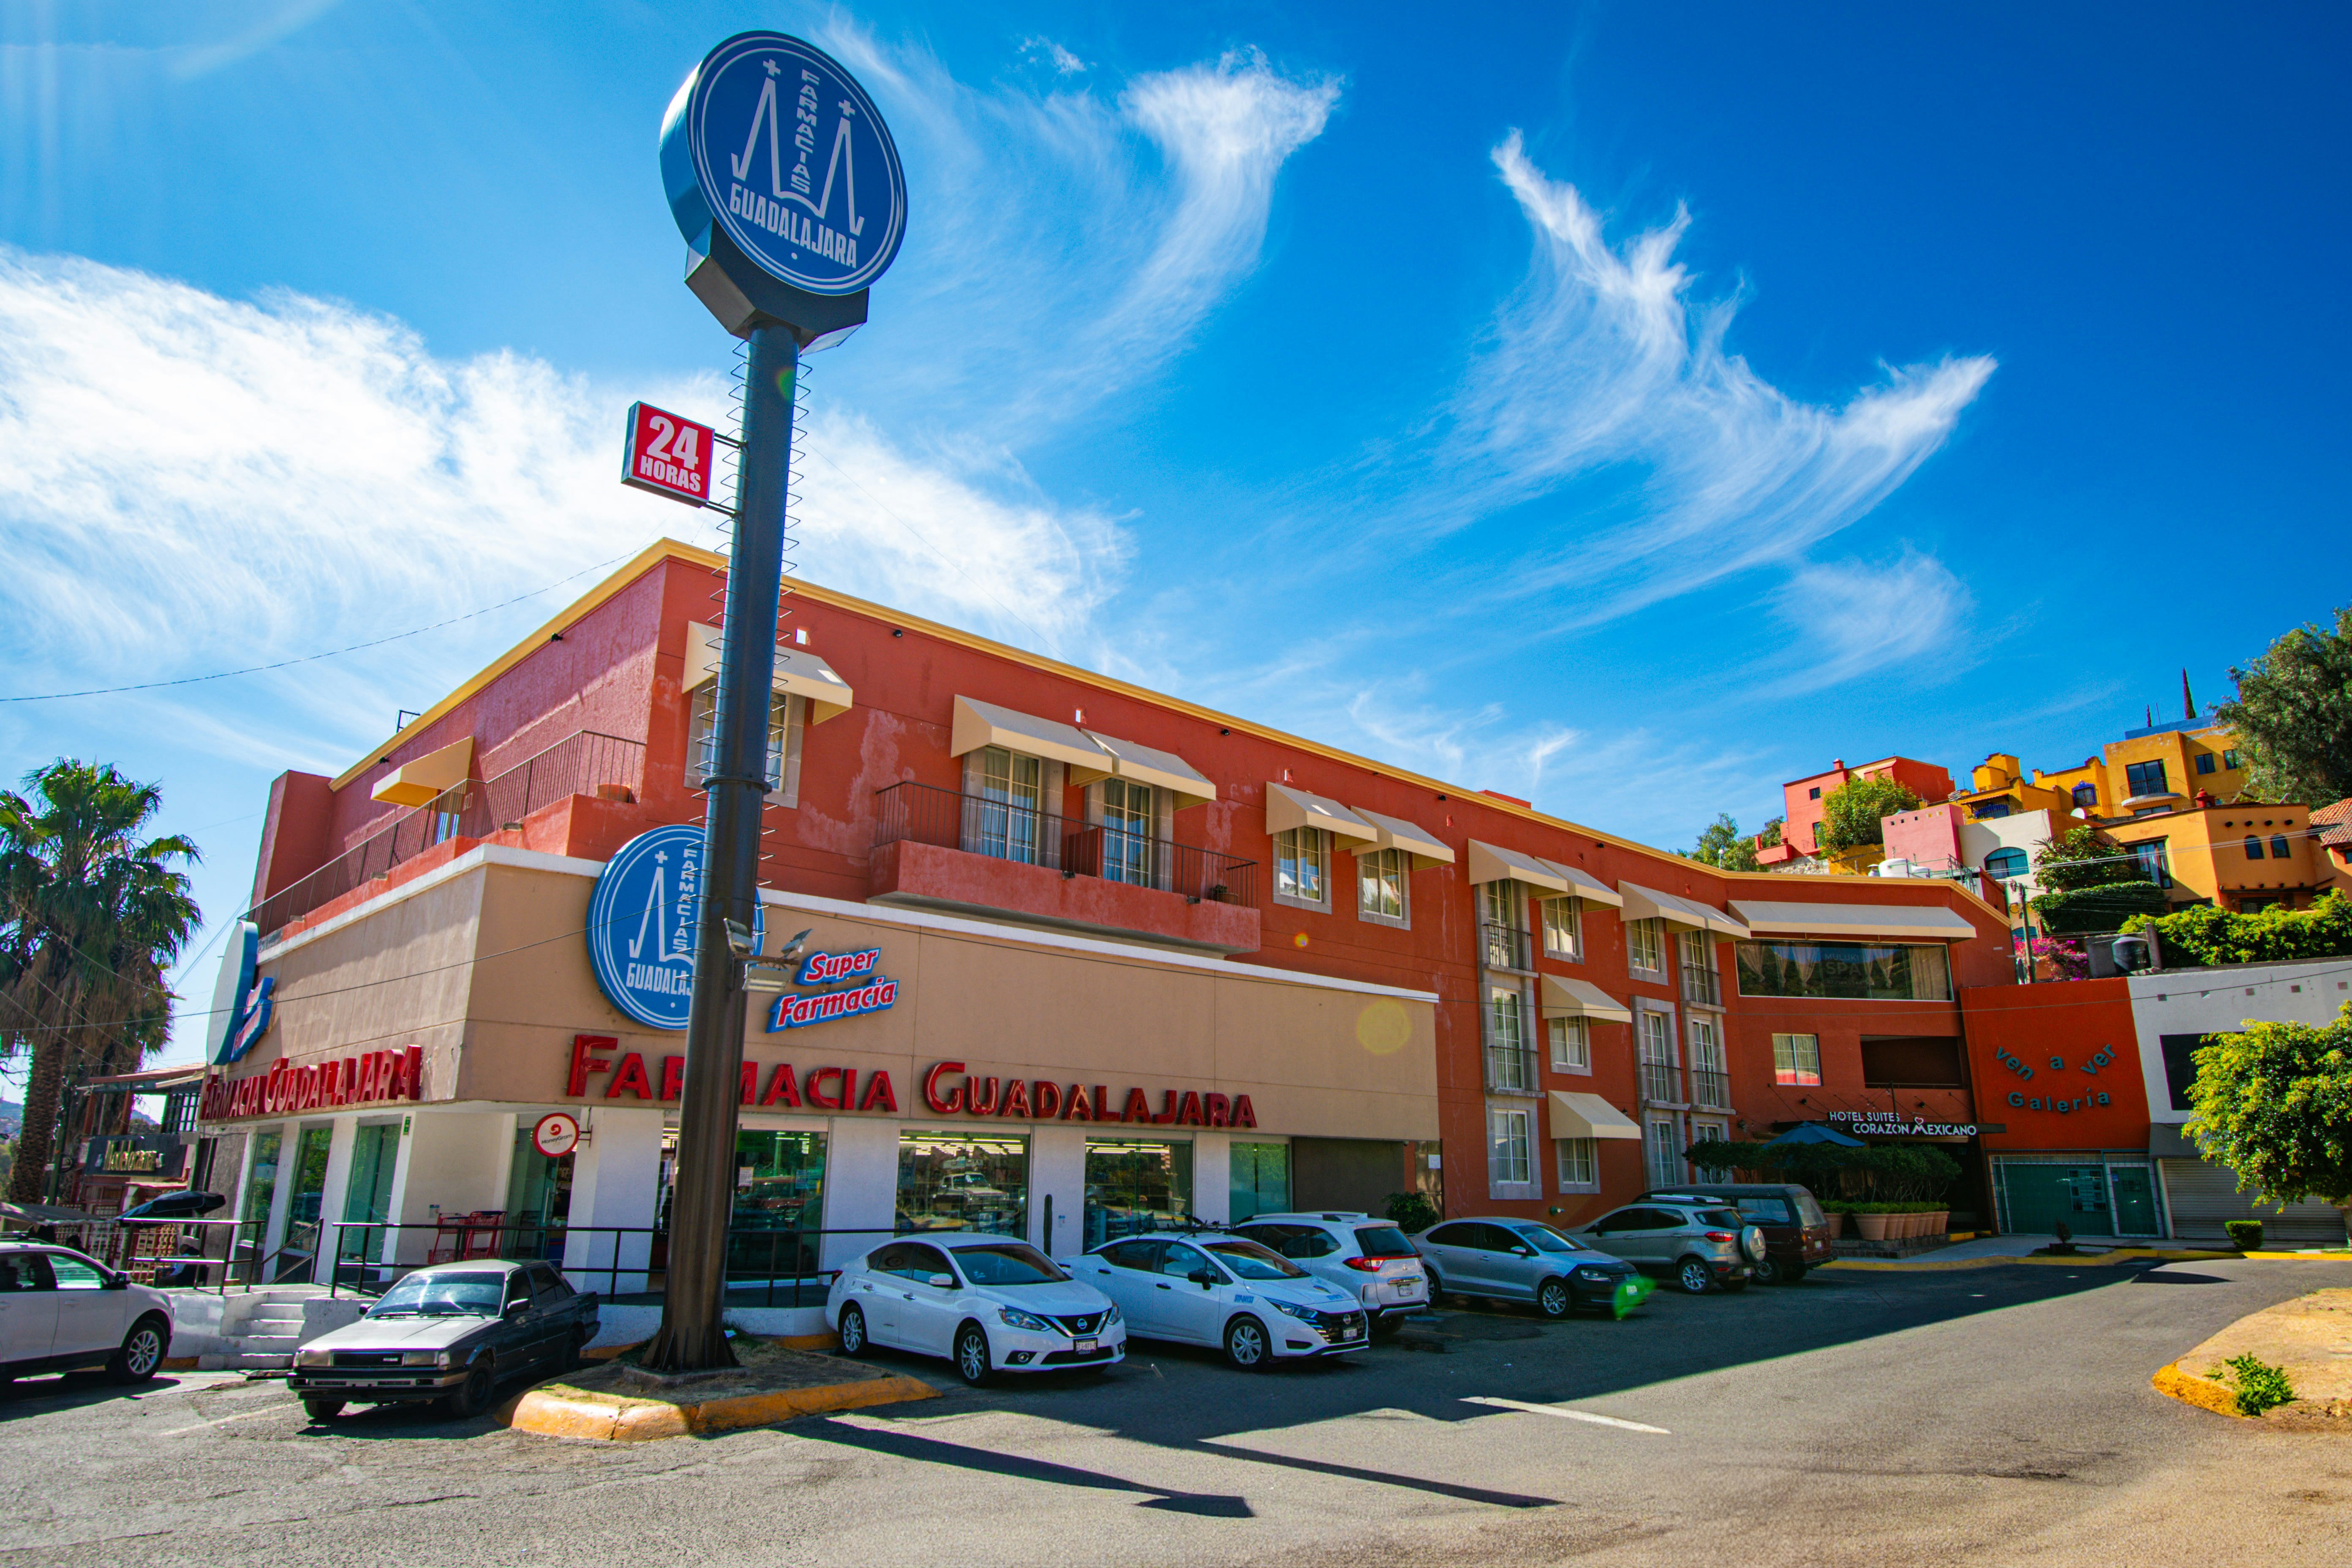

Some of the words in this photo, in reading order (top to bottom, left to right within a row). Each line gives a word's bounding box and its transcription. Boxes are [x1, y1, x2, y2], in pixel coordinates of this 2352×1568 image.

[790, 69, 819, 194] FARMACIAS
[729, 182, 857, 269] GUADALAJARA
[646, 415, 699, 471] 24
[640, 455, 701, 493] HORAS
[672, 848, 698, 951] FARMACIAS
[804, 949, 879, 981] Super
[1826, 961, 1862, 975] SPA
[776, 977, 897, 1028] Farmacia
[1996, 1046, 2034, 1081] ven
[2050, 1056, 2064, 1070] a
[2080, 1043, 2116, 1075] ver
[200, 1074, 268, 1120] FARMACIA
[264, 1045, 422, 1113] GUADALAJARA
[922, 1062, 1258, 1129] GUADALAJARA
[2008, 1087, 2110, 1113] Galería
[1829, 1111, 1864, 1122] HOTEL
[1867, 1112, 1900, 1122] SUITES
[1852, 1123, 1909, 1135] CORAZON
[1911, 1124, 1977, 1136] MEXICANO
[541, 1134, 573, 1145] MoneyGram
